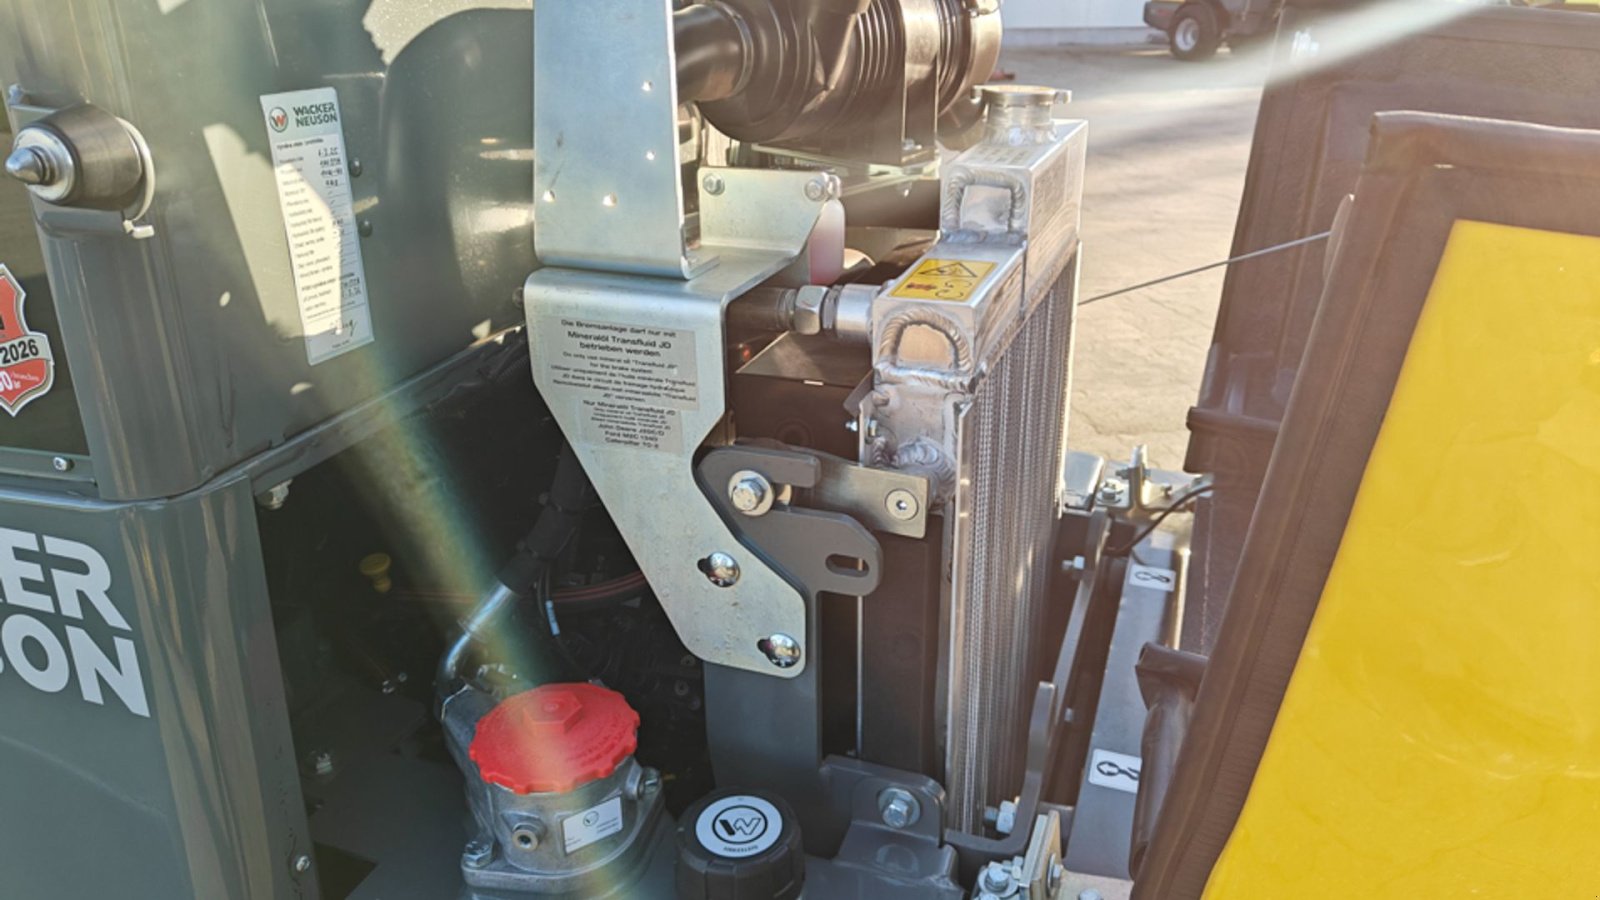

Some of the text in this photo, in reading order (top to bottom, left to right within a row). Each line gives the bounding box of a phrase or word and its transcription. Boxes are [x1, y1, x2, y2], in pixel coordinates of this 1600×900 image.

[292, 102, 336, 117] WACKER
[295, 113, 338, 128] NEUSON
[561, 319, 574, 327] Die
[576, 320, 628, 334] Bremsanlage
[630, 325, 646, 335] darf
[567, 330, 609, 343] Mineralöl
[611, 335, 656, 348] Transfluid
[0, 339, 39, 364] 2026
[579, 341, 661, 358] betrieben werden
[0, 527, 133, 632] ER
[0, 613, 151, 718] ON
